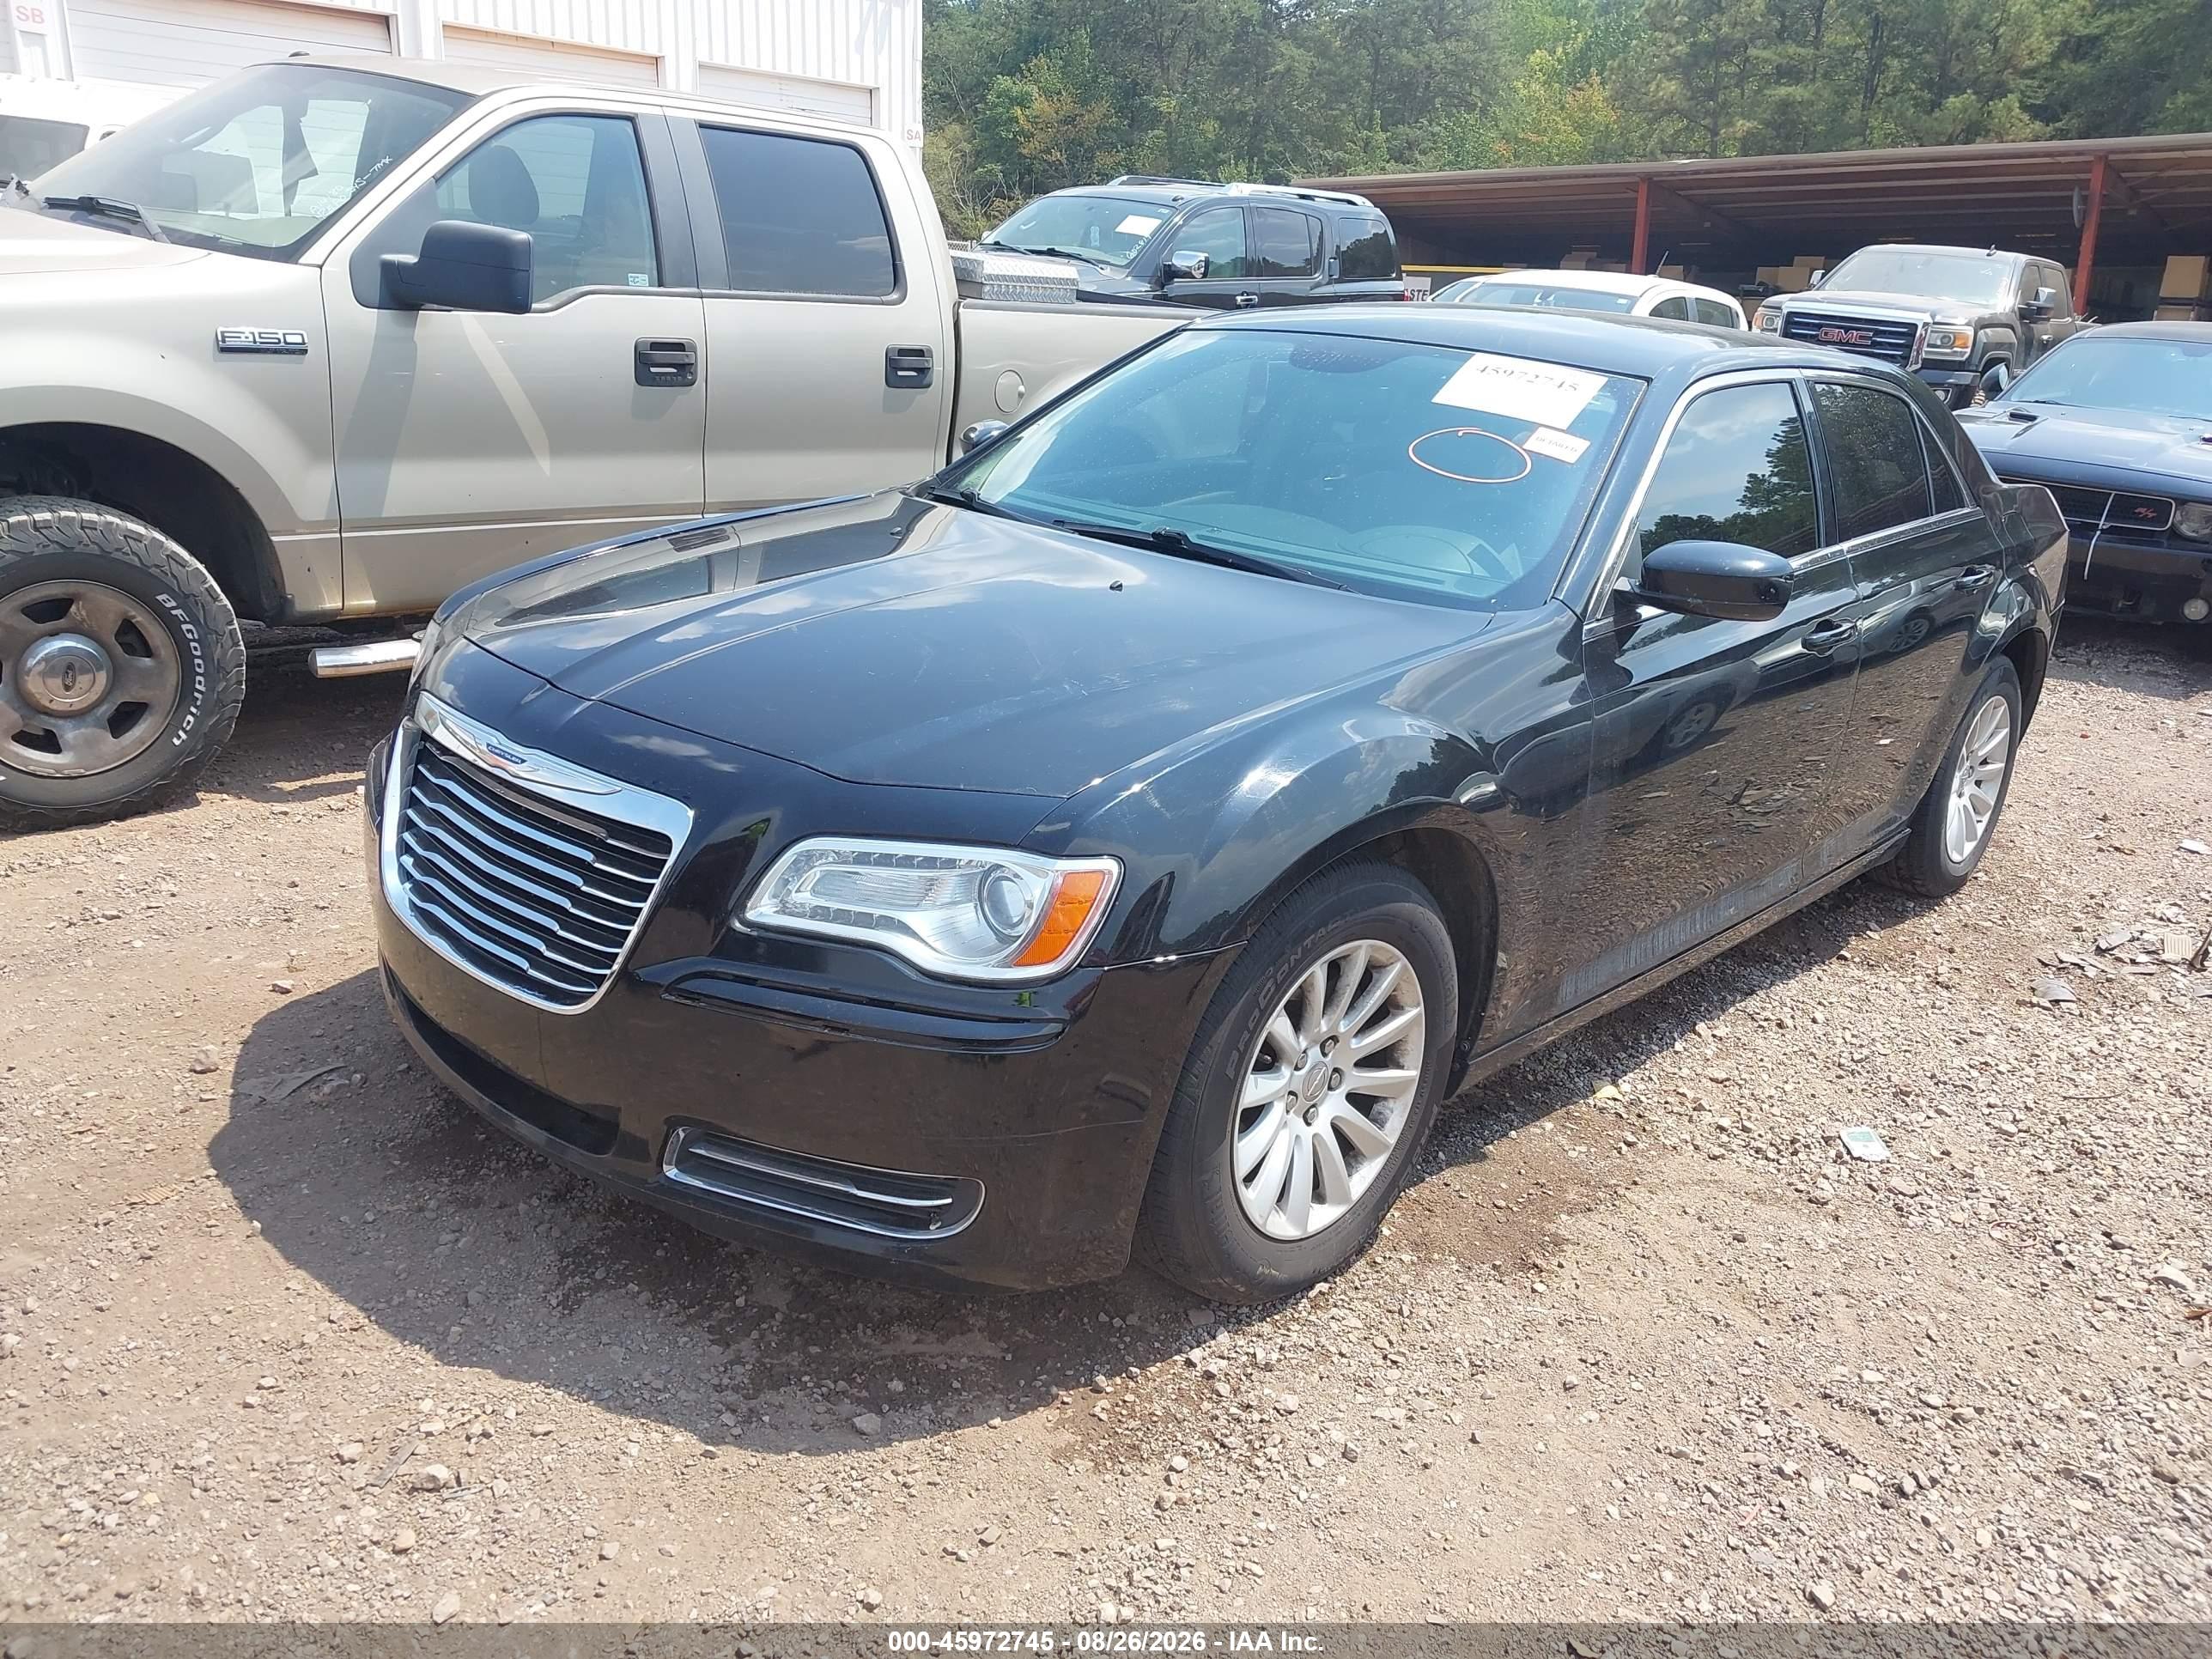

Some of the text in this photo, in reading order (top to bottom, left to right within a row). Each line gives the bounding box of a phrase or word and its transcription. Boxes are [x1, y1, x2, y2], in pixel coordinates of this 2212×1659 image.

[15, 5, 46, 24] SB
[906, 129, 921, 142] SA
[1819, 327, 1874, 345] GMC
